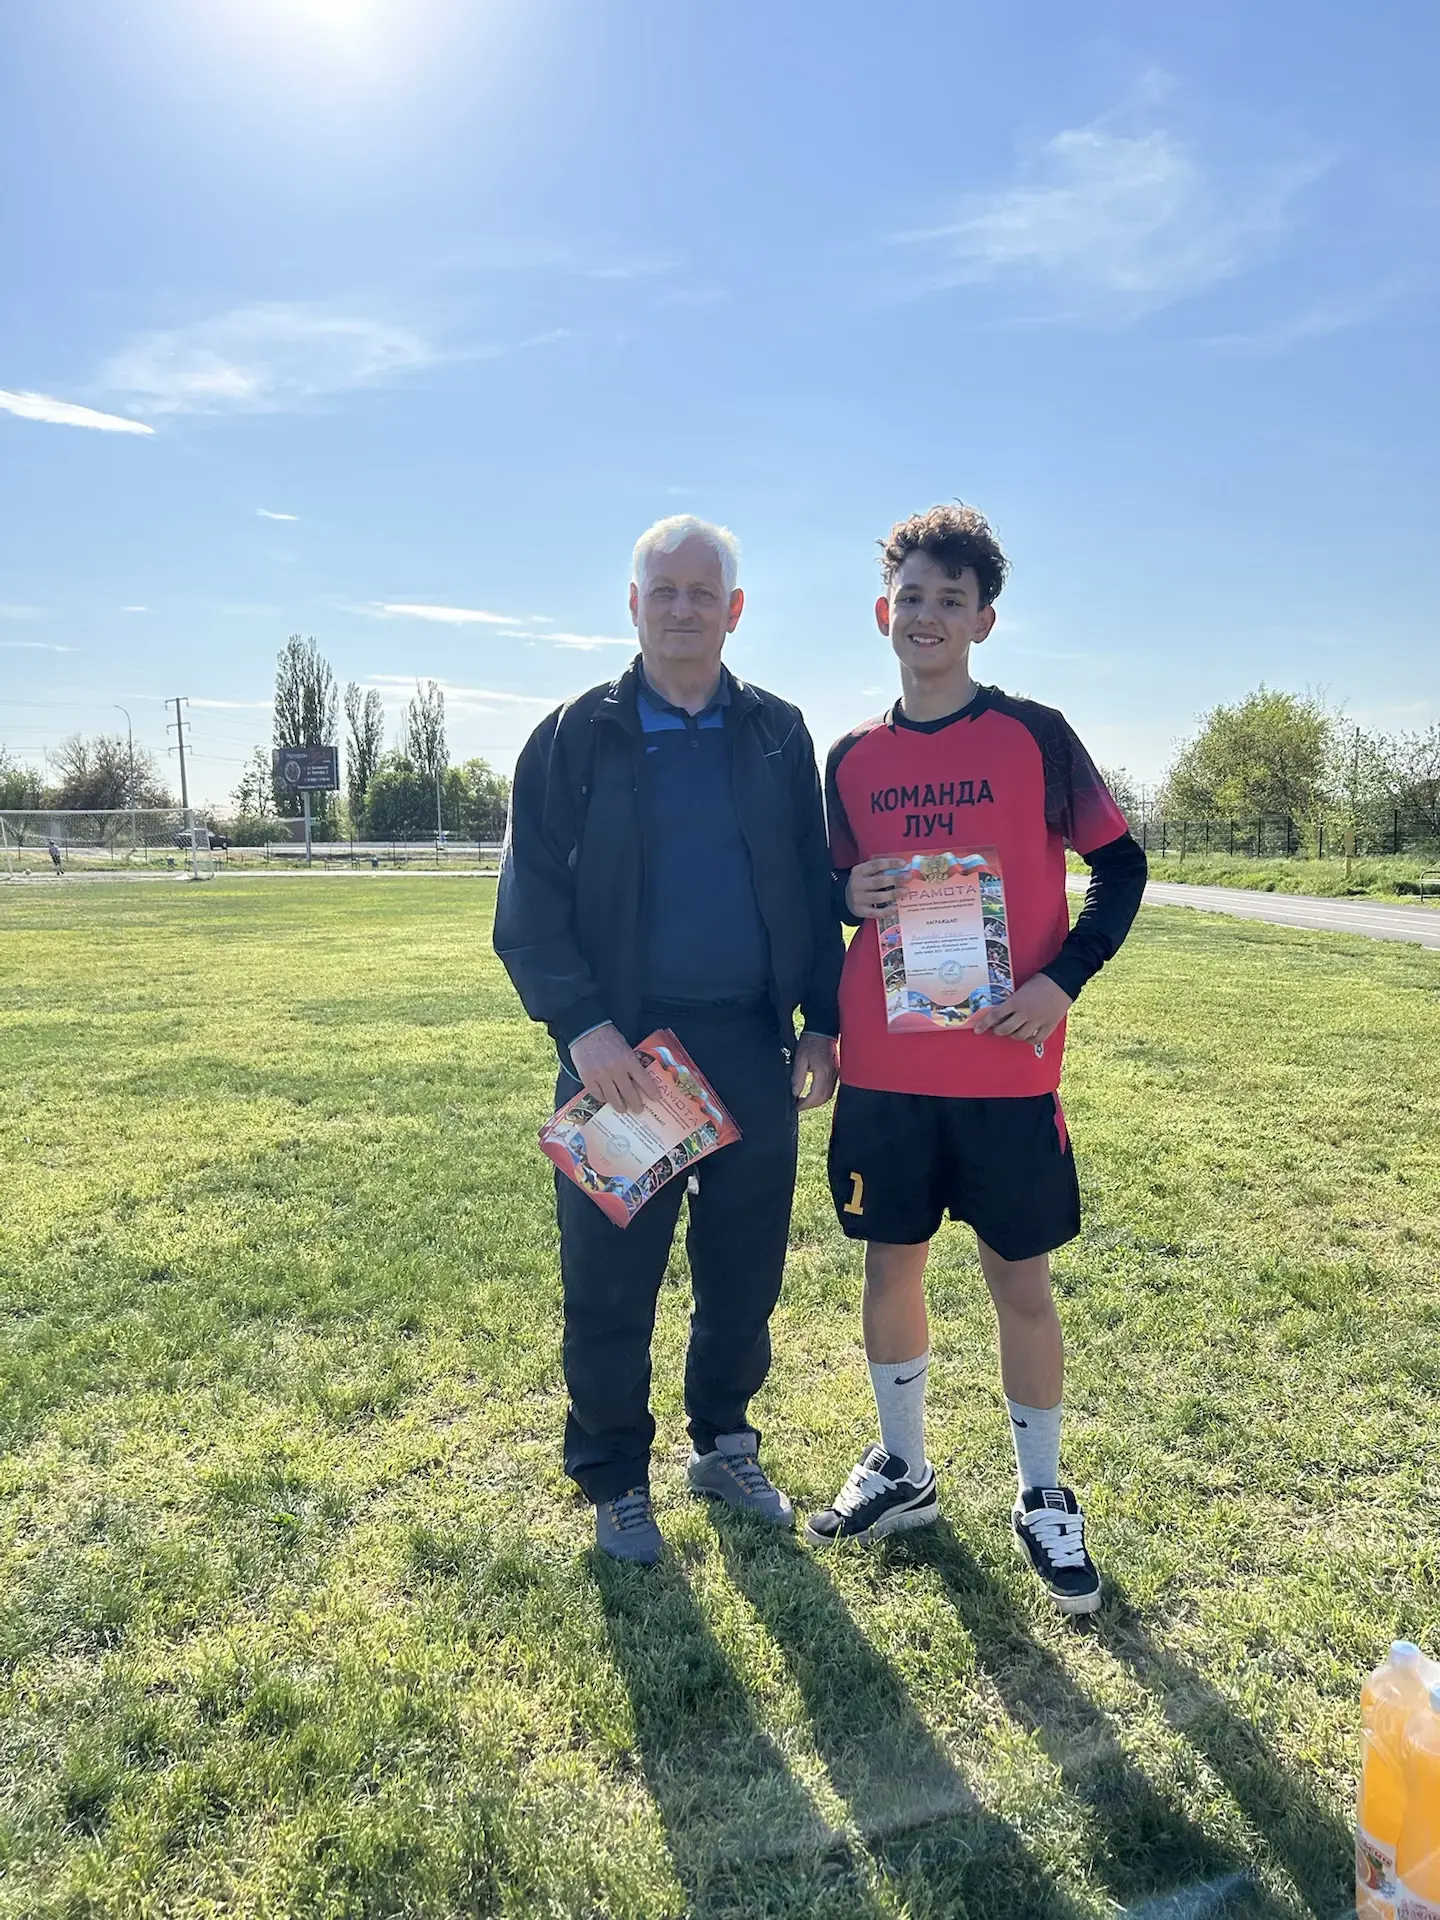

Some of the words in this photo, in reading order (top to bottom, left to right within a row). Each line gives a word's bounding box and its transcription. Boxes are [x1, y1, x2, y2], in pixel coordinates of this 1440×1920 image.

[871, 779, 994, 814] КОМАНДА
[903, 813, 954, 838] ЛУЧ
[843, 1171, 864, 1216] 1
